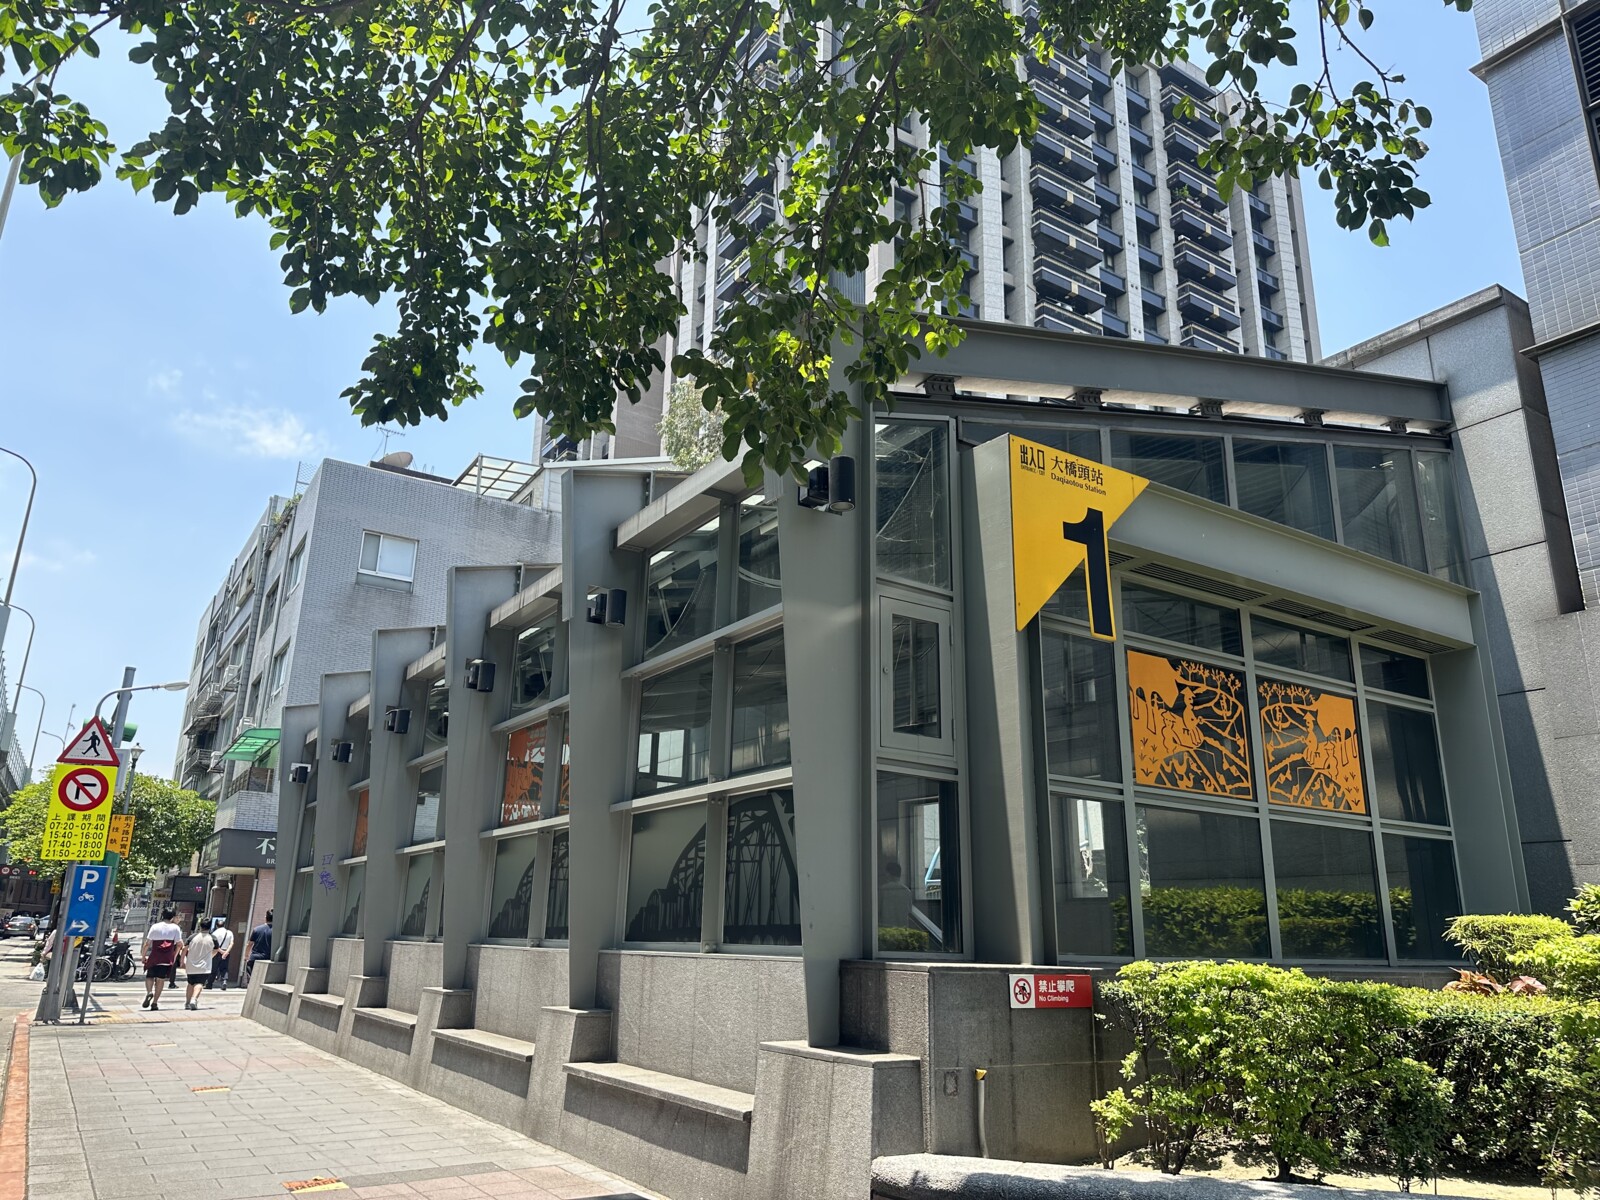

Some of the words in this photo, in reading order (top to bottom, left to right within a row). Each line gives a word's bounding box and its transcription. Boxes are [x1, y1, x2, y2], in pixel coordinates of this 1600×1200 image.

[1019, 444, 1046, 470] 出入口
[1050, 455, 1104, 486] 大橋頭站
[1051, 472, 1084, 488] Daqiaotou
[1084, 482, 1107, 496] Station
[1062, 506, 1113, 637] 1
[51, 813, 106, 822] 上課期間
[80, 869, 100, 890] P
[1038, 979, 1075, 993] 禁止攀爬
[1047, 994, 1069, 1003] Climbing
